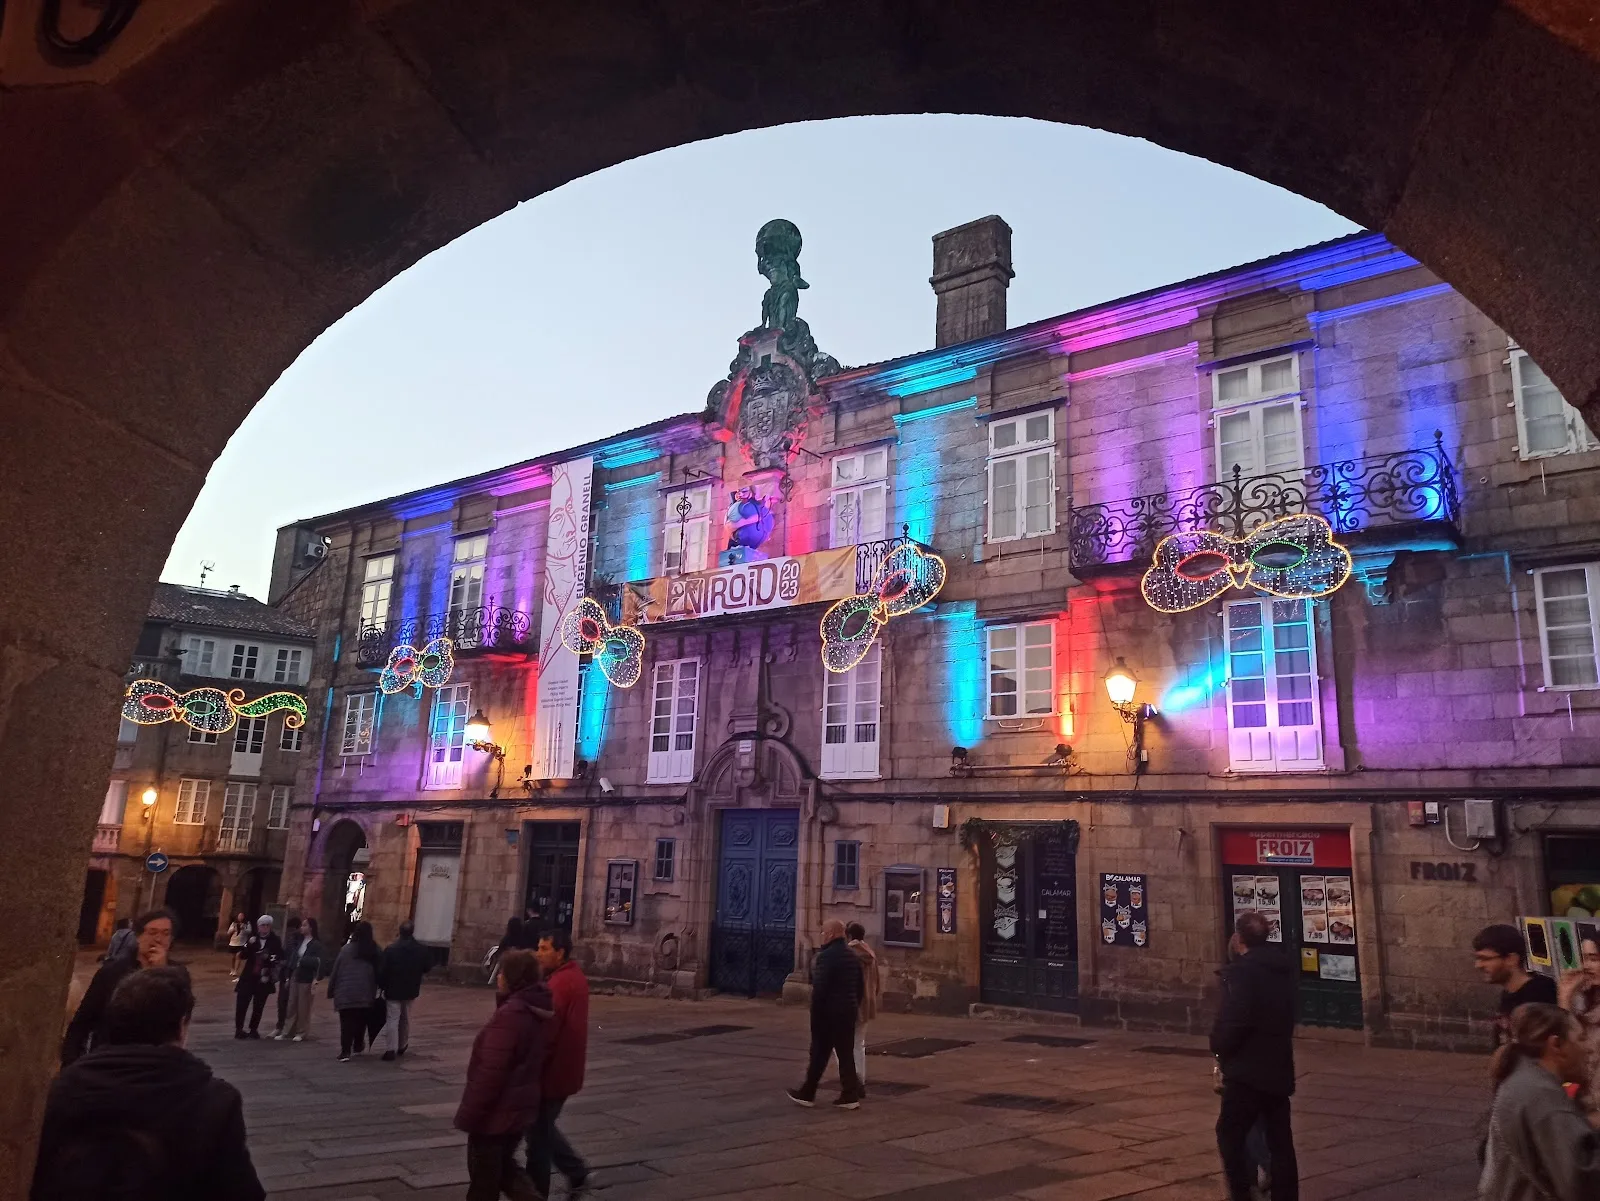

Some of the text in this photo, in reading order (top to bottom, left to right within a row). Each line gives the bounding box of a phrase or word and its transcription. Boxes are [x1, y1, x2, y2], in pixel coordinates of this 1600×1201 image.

[576, 472, 592, 599] EUGENIO GRANELL
[1249, 831, 1320, 839] supermercado
[1259, 840, 1311, 857] FROIZ
[1409, 861, 1478, 882] FROIZ
[1041, 888, 1072, 897] CALAMAR
